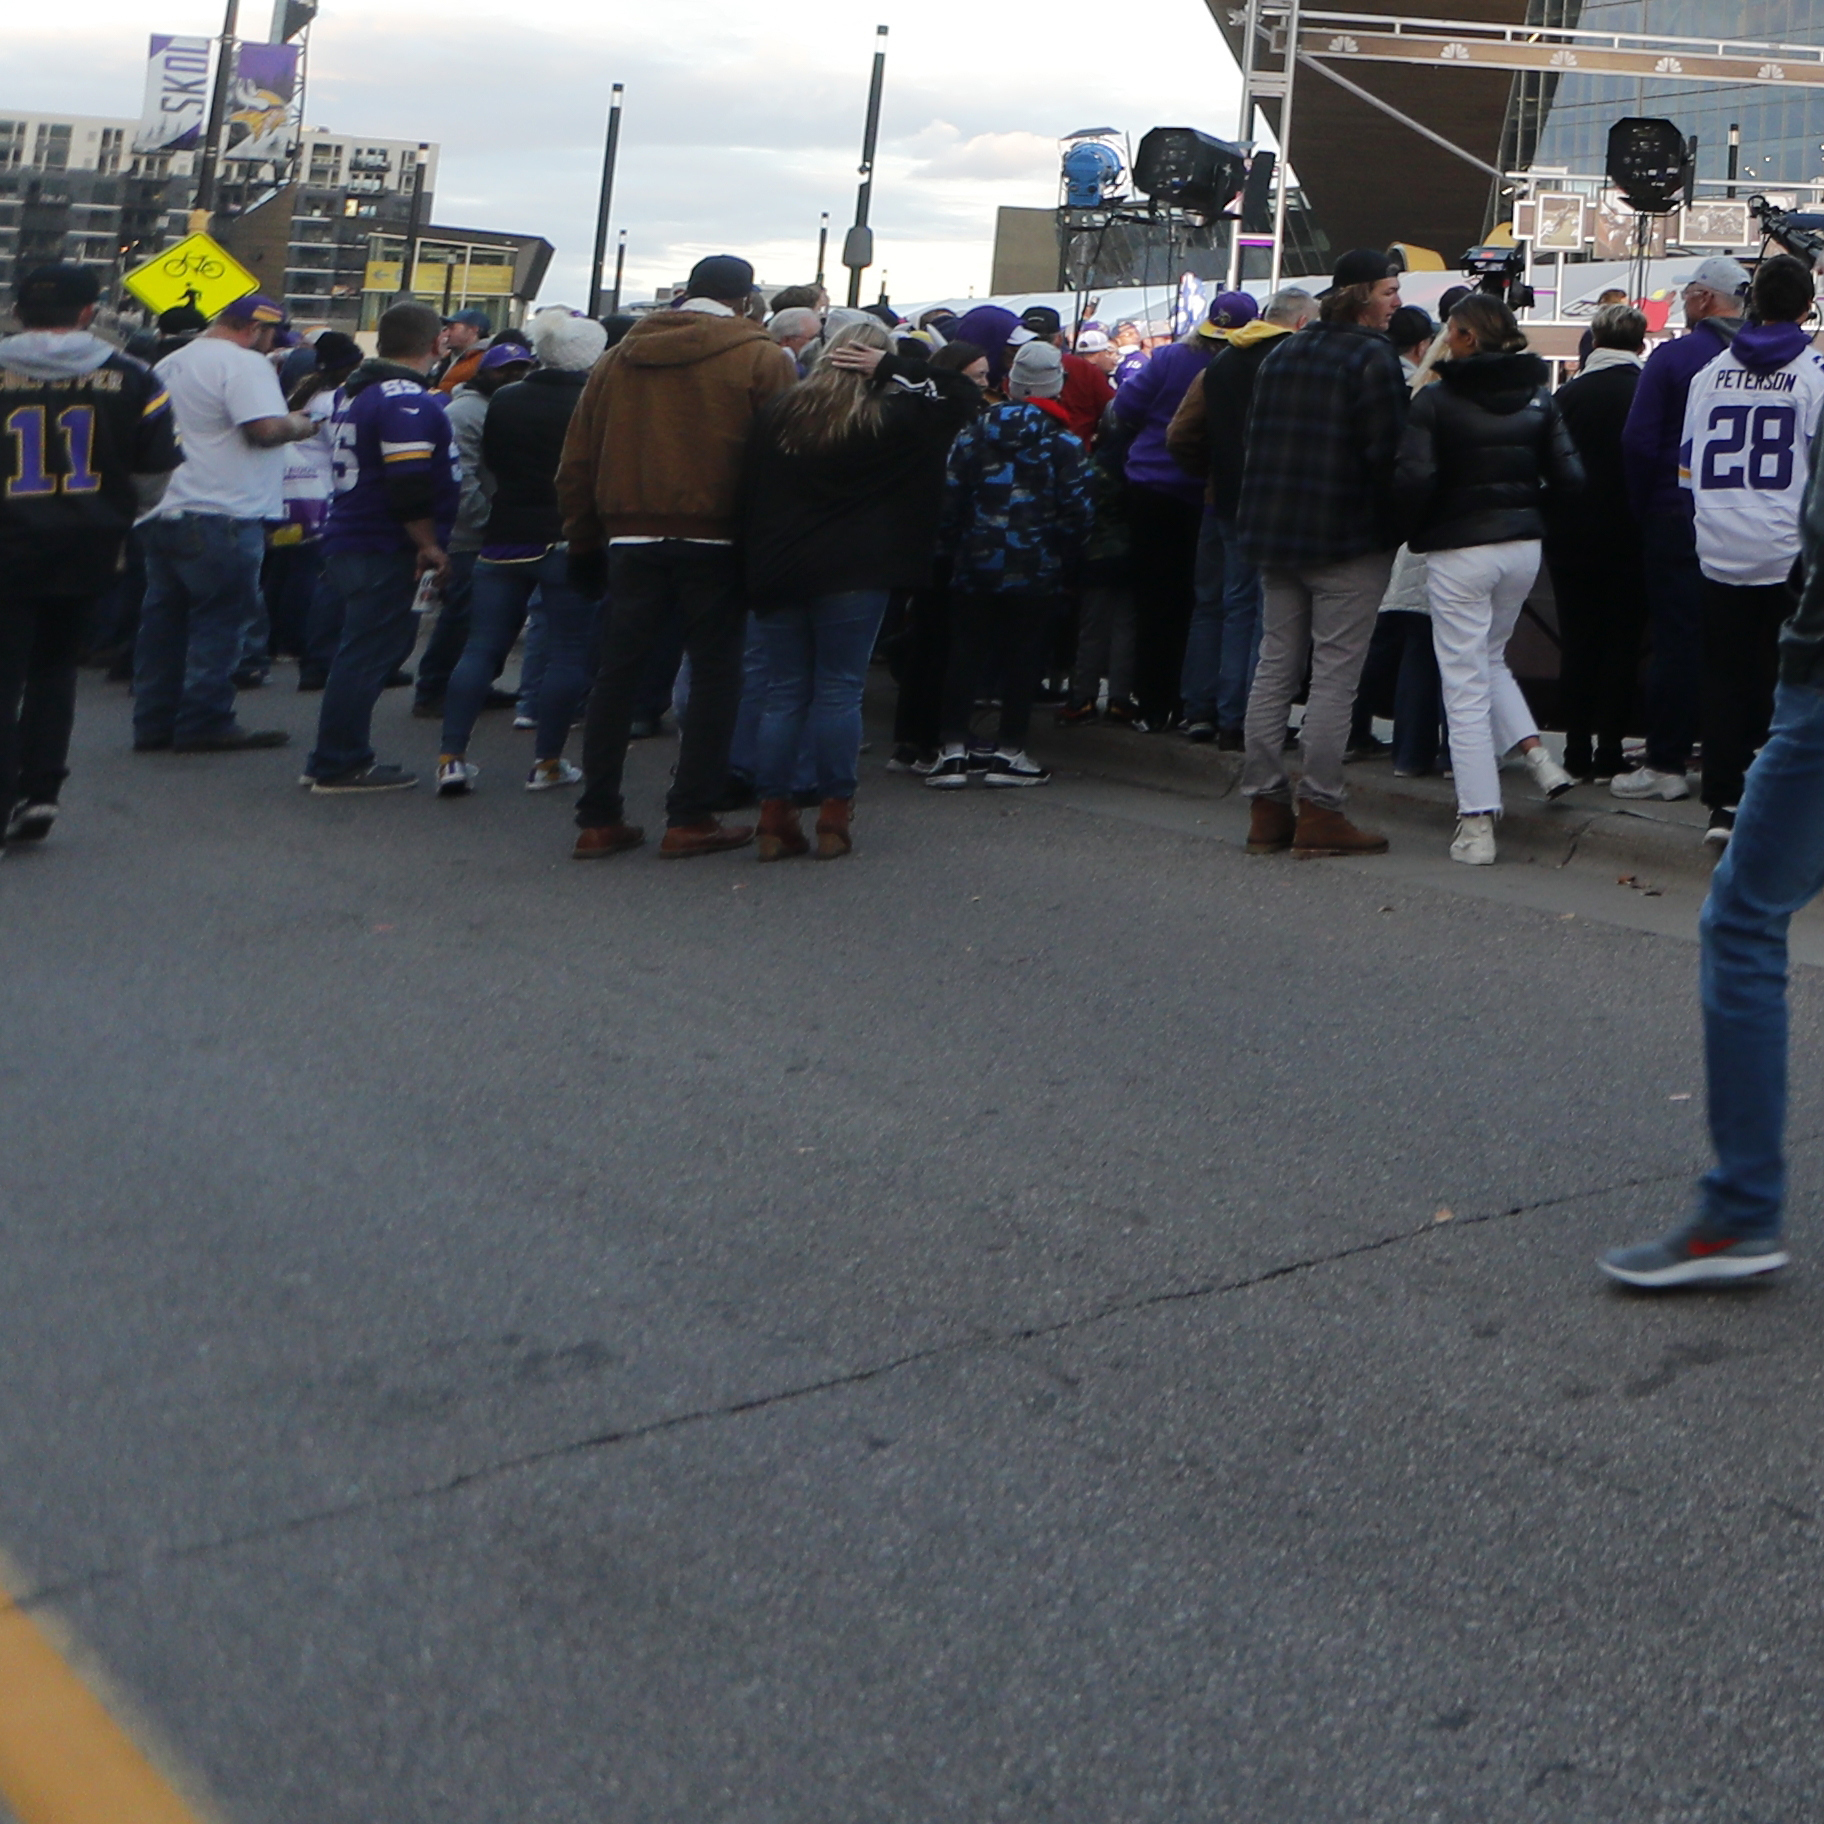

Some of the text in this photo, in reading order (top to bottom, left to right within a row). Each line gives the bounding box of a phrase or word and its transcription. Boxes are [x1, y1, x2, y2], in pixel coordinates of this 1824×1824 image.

[161, 39, 210, 116] SKOL
[1714, 369, 1797, 393] PETERSON
[6, 404, 102, 497] 11
[1701, 405, 1795, 490] 28
